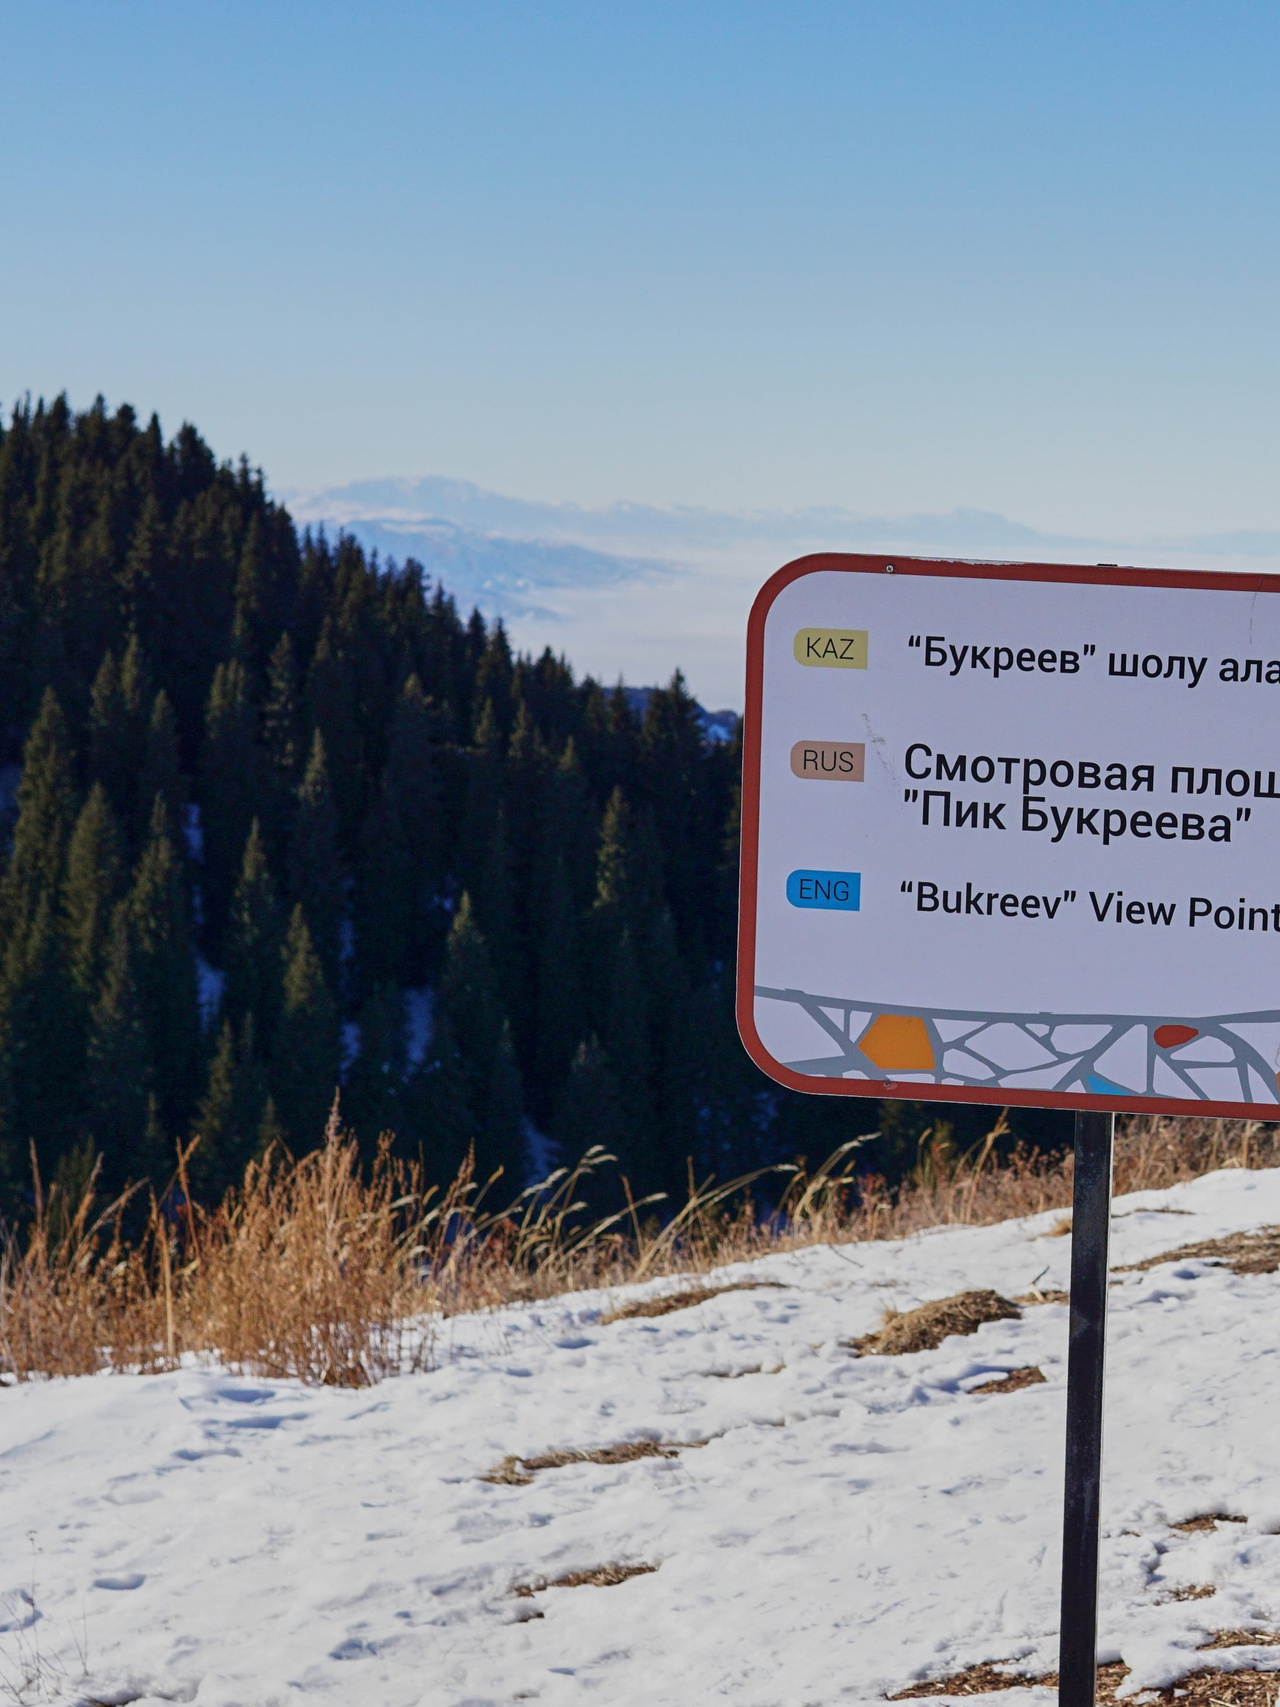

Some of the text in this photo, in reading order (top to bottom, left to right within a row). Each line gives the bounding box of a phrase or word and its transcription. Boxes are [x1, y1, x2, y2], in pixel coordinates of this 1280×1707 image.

[805, 636, 855, 661] KAZ
[1108, 652, 1209, 689] шолу
[801, 748, 854, 774] RUS
[904, 742, 1156, 796] Смотровая
[799, 878, 850, 902] ENG
[1088, 890, 1178, 926] View
